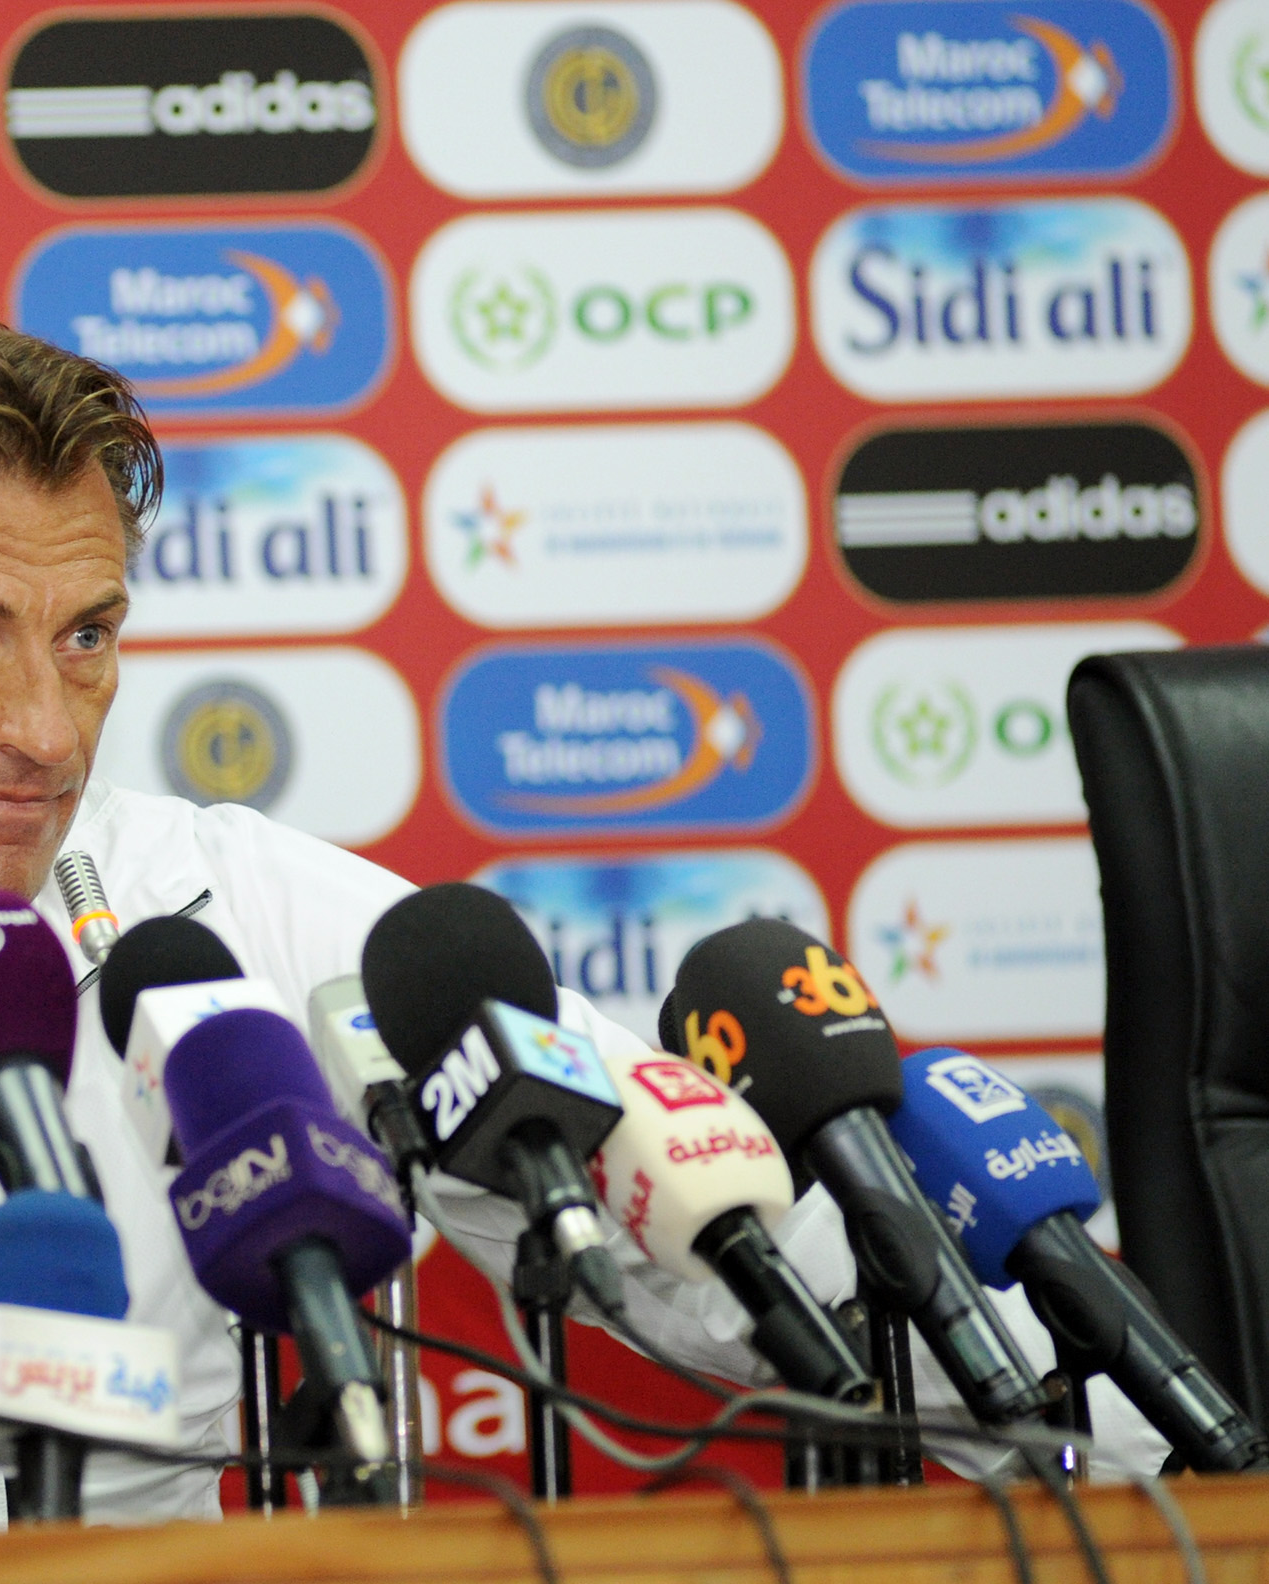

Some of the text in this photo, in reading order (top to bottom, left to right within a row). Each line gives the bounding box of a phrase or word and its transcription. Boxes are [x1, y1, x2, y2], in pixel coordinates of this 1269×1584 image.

[896, 29, 1039, 78] Maroc
[150, 69, 377, 136] adidas
[861, 78, 1043, 132] Telecom
[110, 267, 255, 317] Maroc
[571, 282, 756, 343] OCP
[847, 243, 1159, 355] Sidi ali
[74, 314, 259, 364] Telecom
[256, 491, 372, 581] ali
[981, 474, 1199, 545] adidas
[533, 684, 675, 733] Maroc
[498, 730, 682, 784] Telecom
[547, 908, 658, 997] idi
[421, 1024, 502, 1141] 2M
